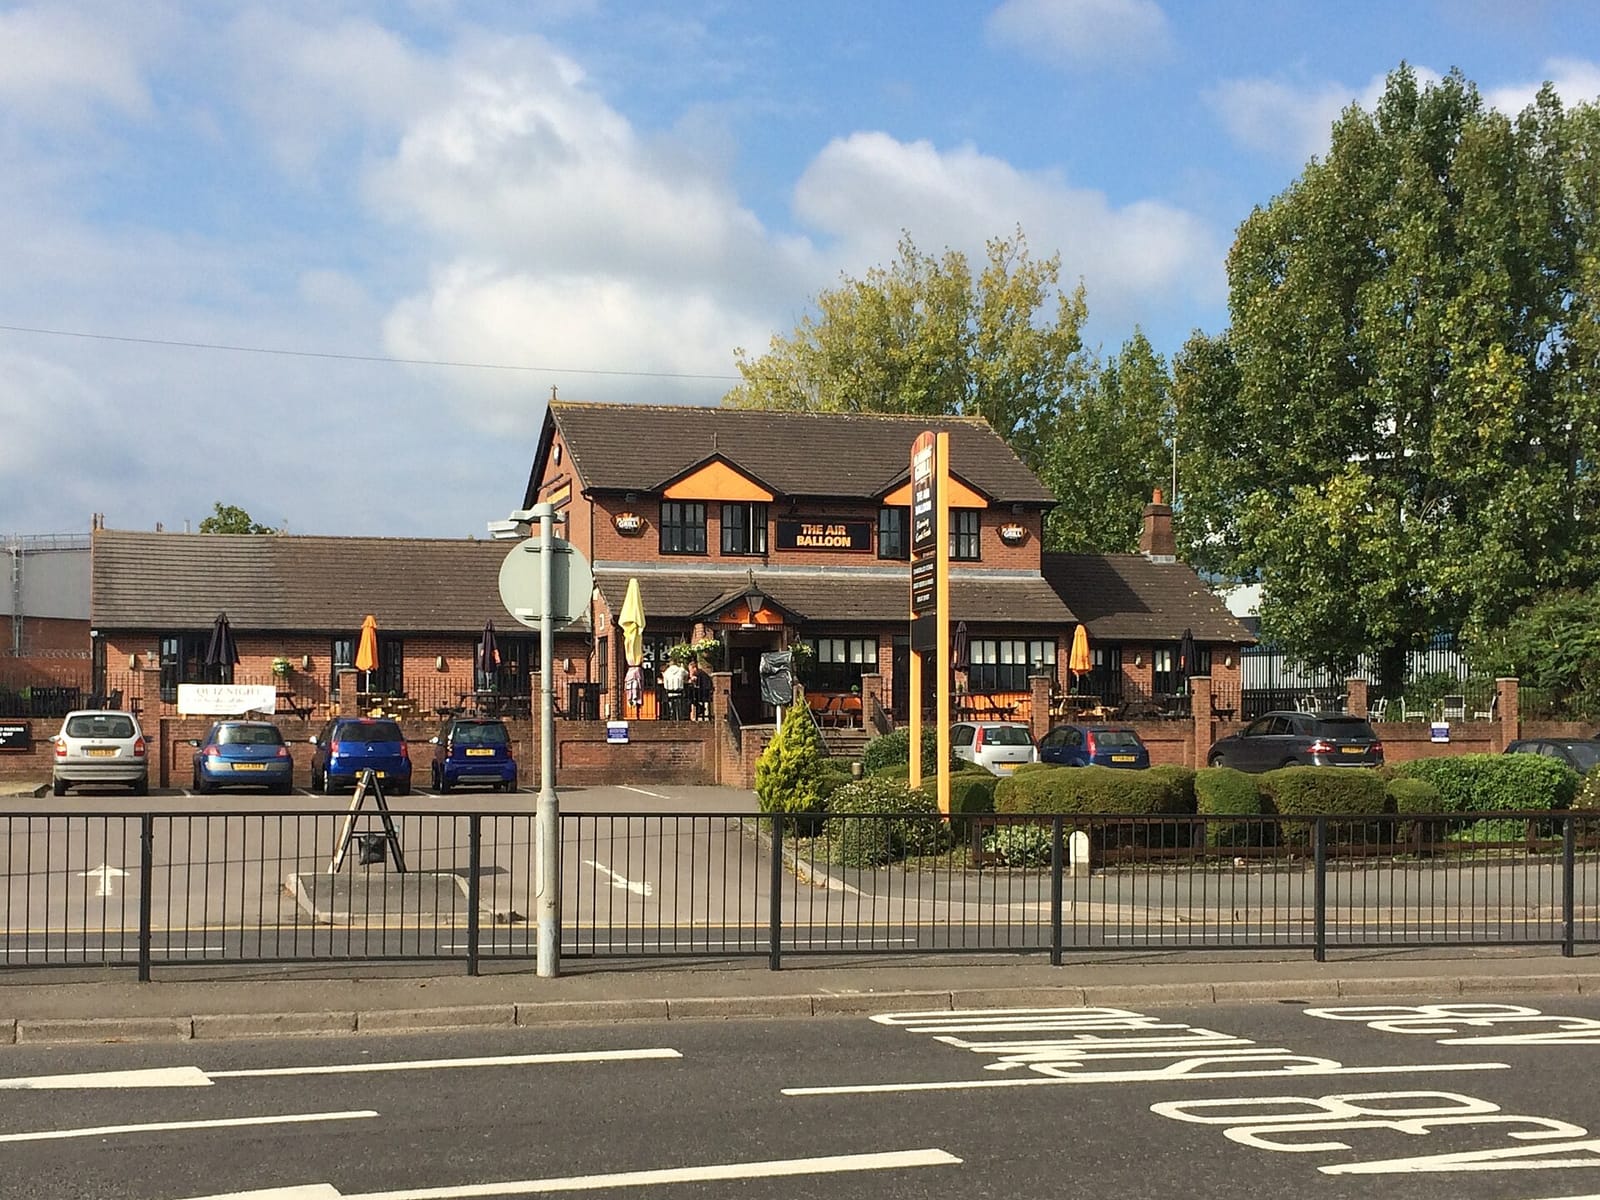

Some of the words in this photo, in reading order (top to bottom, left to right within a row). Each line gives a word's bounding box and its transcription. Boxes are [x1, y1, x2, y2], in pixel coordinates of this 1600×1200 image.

[800, 523, 823, 535] THE
[825, 524, 847, 536] AIR
[796, 535, 852, 547] BALLOON
[196, 687, 224, 698] QUIZ
[1149, 1091, 1600, 1175] A38
